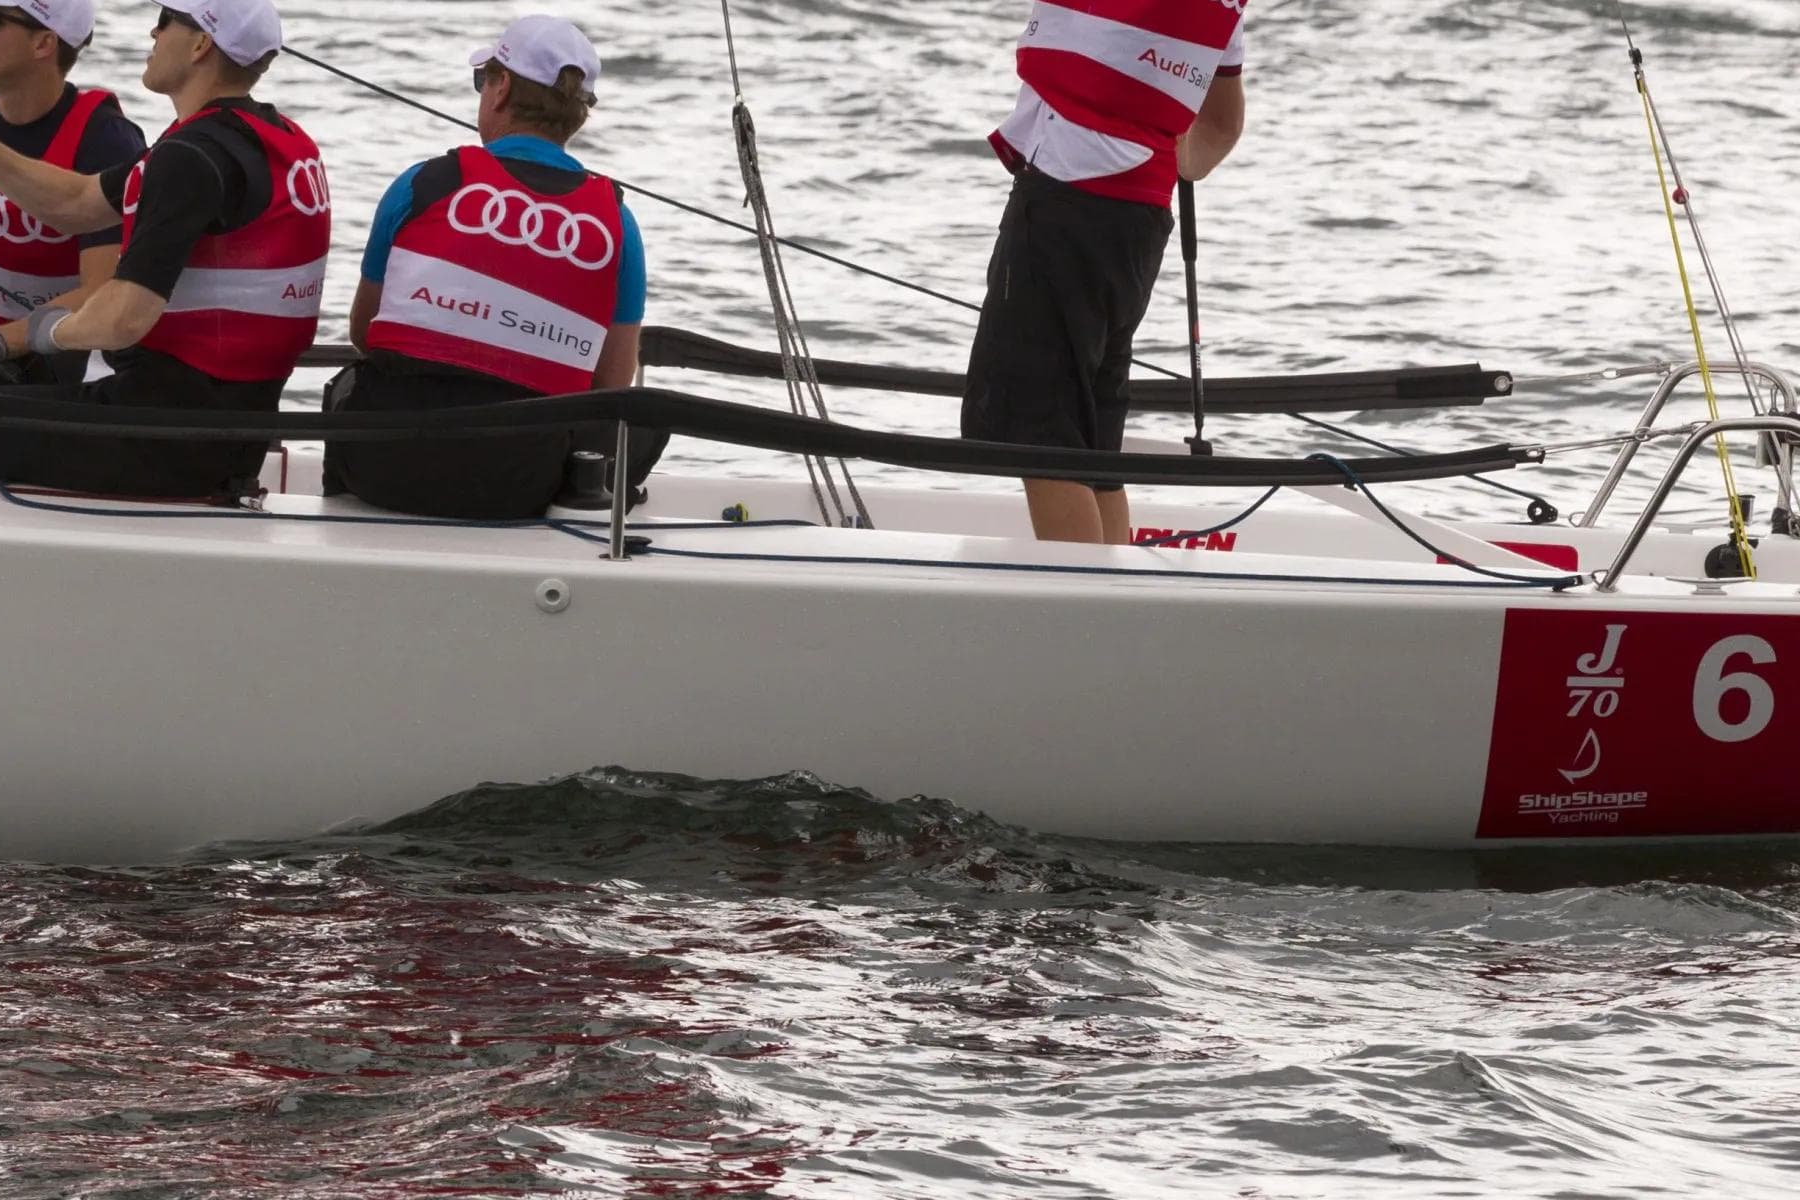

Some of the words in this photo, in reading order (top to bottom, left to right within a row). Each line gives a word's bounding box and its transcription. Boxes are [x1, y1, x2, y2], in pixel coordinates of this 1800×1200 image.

[1137, 47, 1189, 80] Audi
[281, 279, 318, 300] Audi
[410, 286, 492, 321] Audi
[498, 309, 593, 356] Sailing
[1575, 623, 1628, 675] J
[1566, 689, 1619, 718] 70
[1692, 634, 1777, 743] 6
[1519, 791, 1648, 809] ShipShape
[1548, 810, 1620, 825] Yachting
